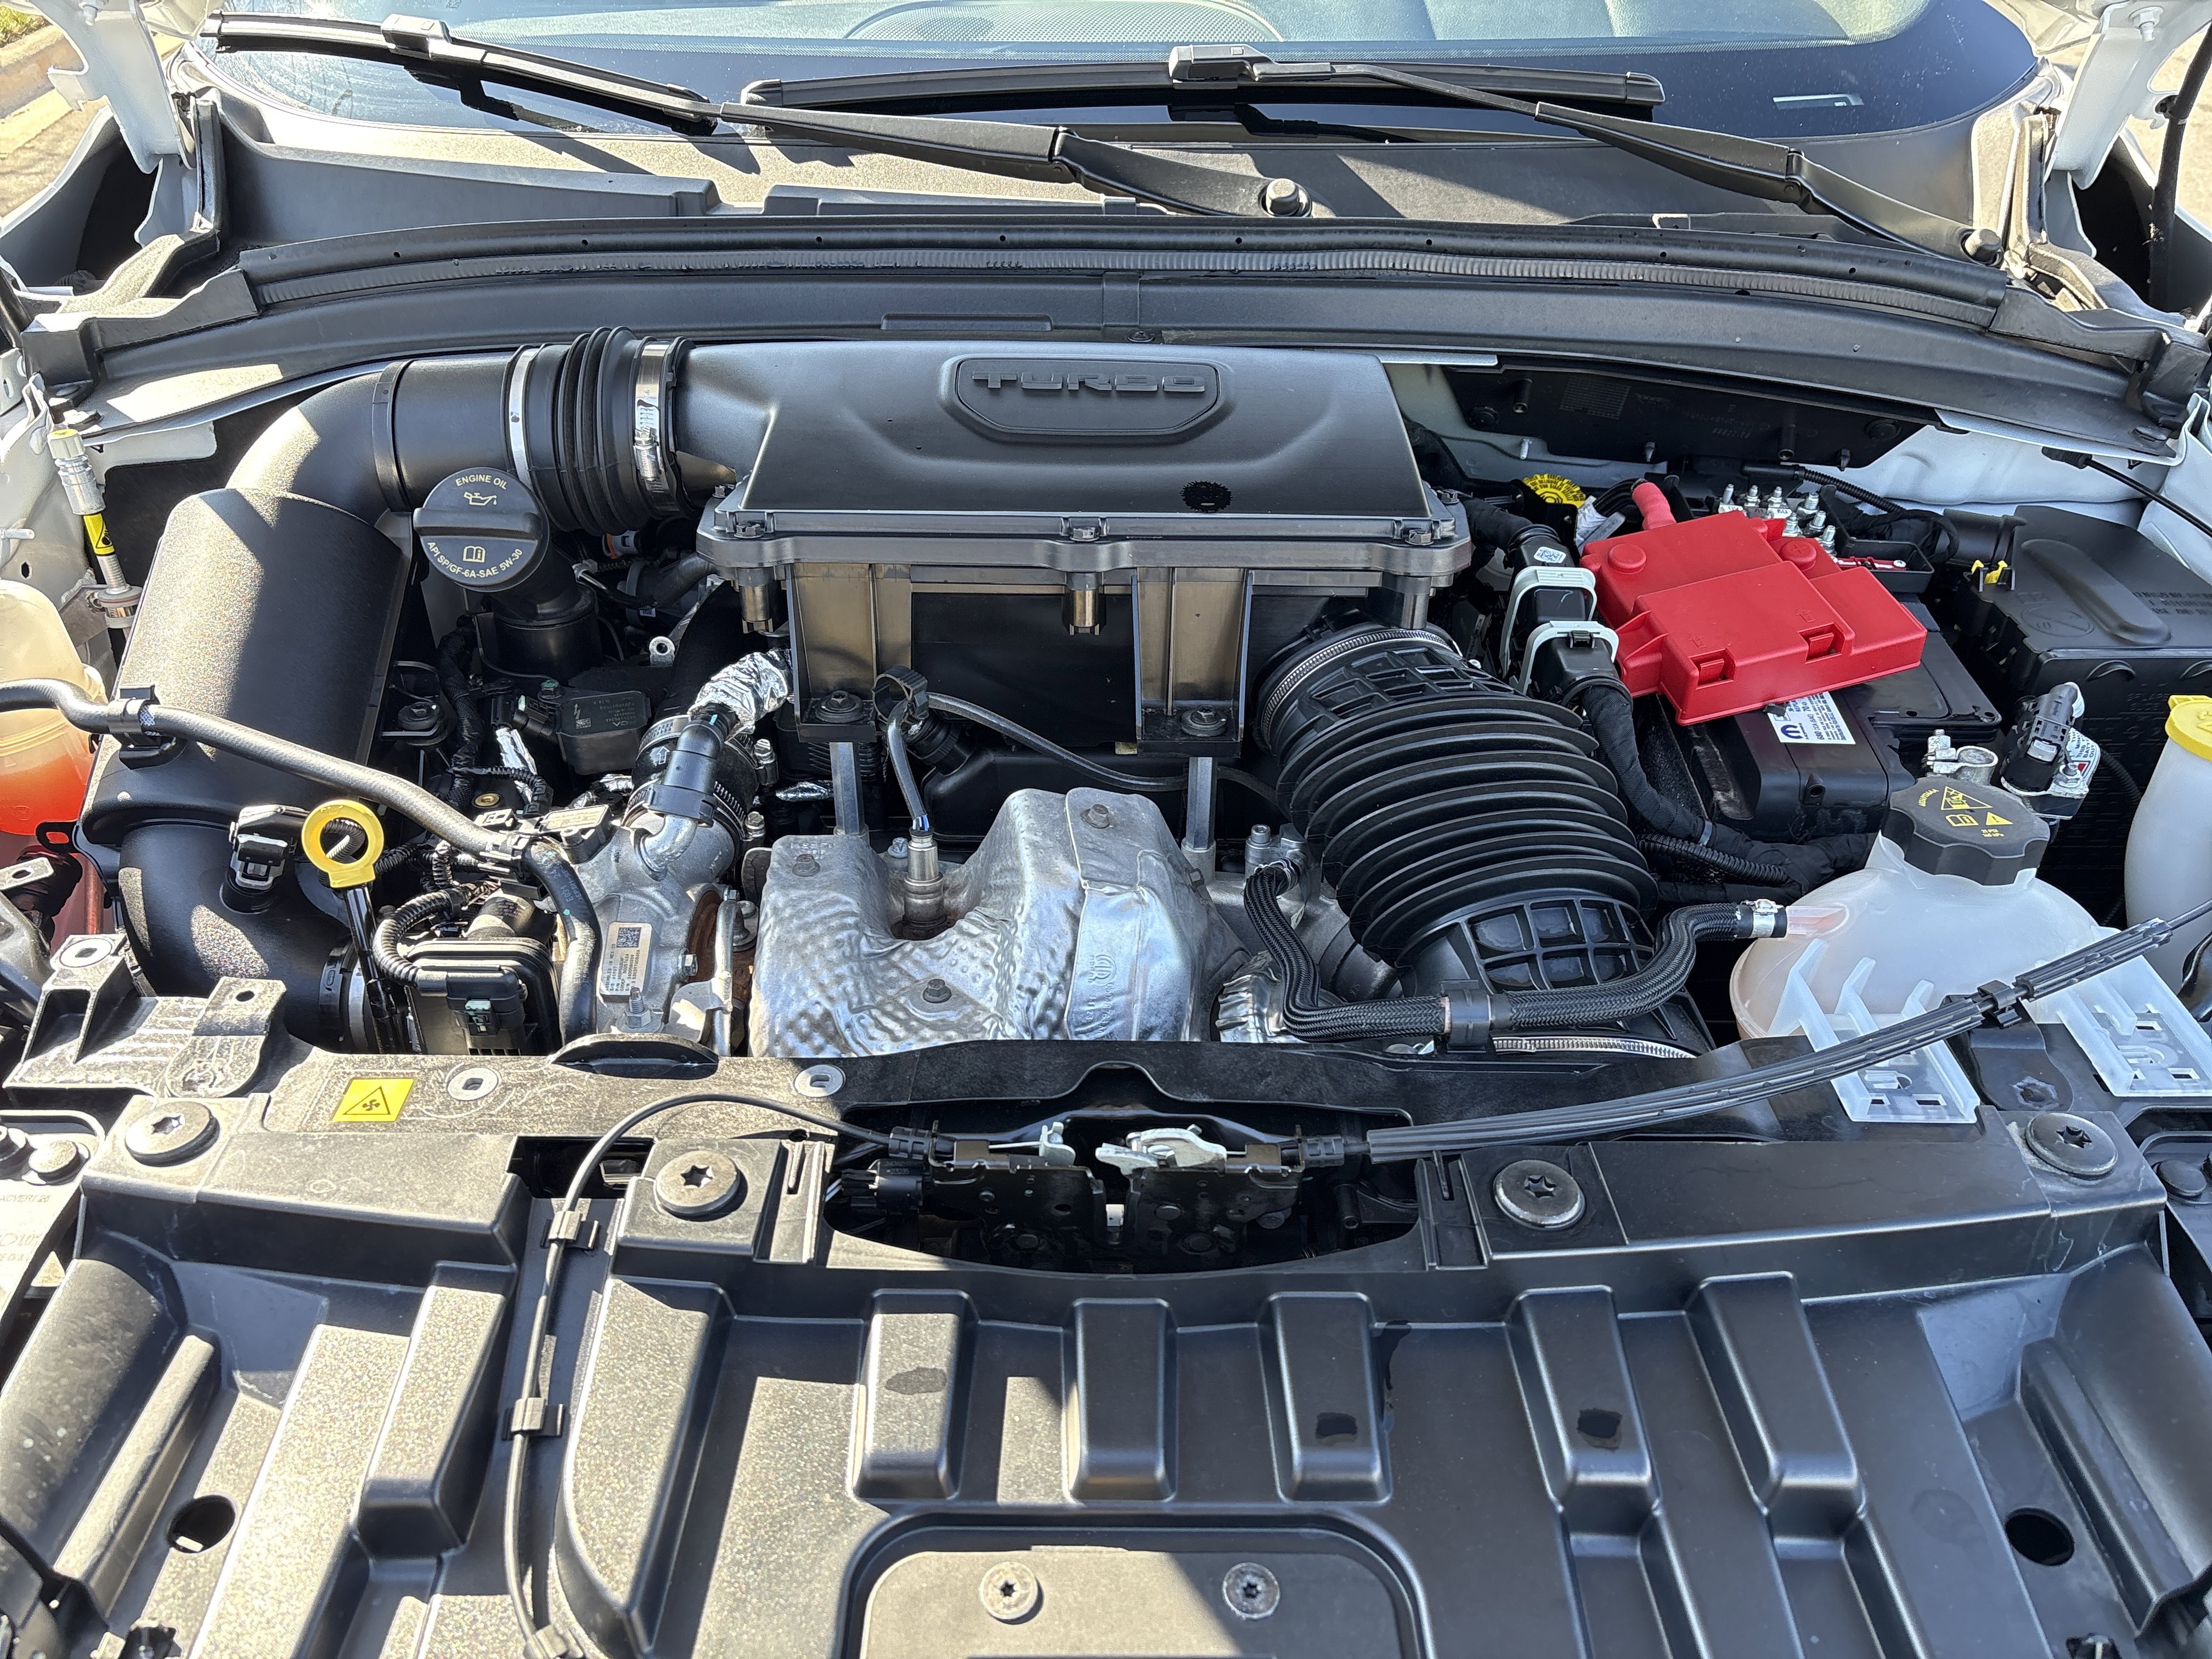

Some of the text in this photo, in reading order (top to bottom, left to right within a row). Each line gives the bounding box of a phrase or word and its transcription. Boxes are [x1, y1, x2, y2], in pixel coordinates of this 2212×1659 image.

[972, 371, 1206, 392] TURBO
[455, 474, 507, 490] ENGINE OIL
[427, 541, 523, 579] API SP/GF-6A-SAE 5W-30
